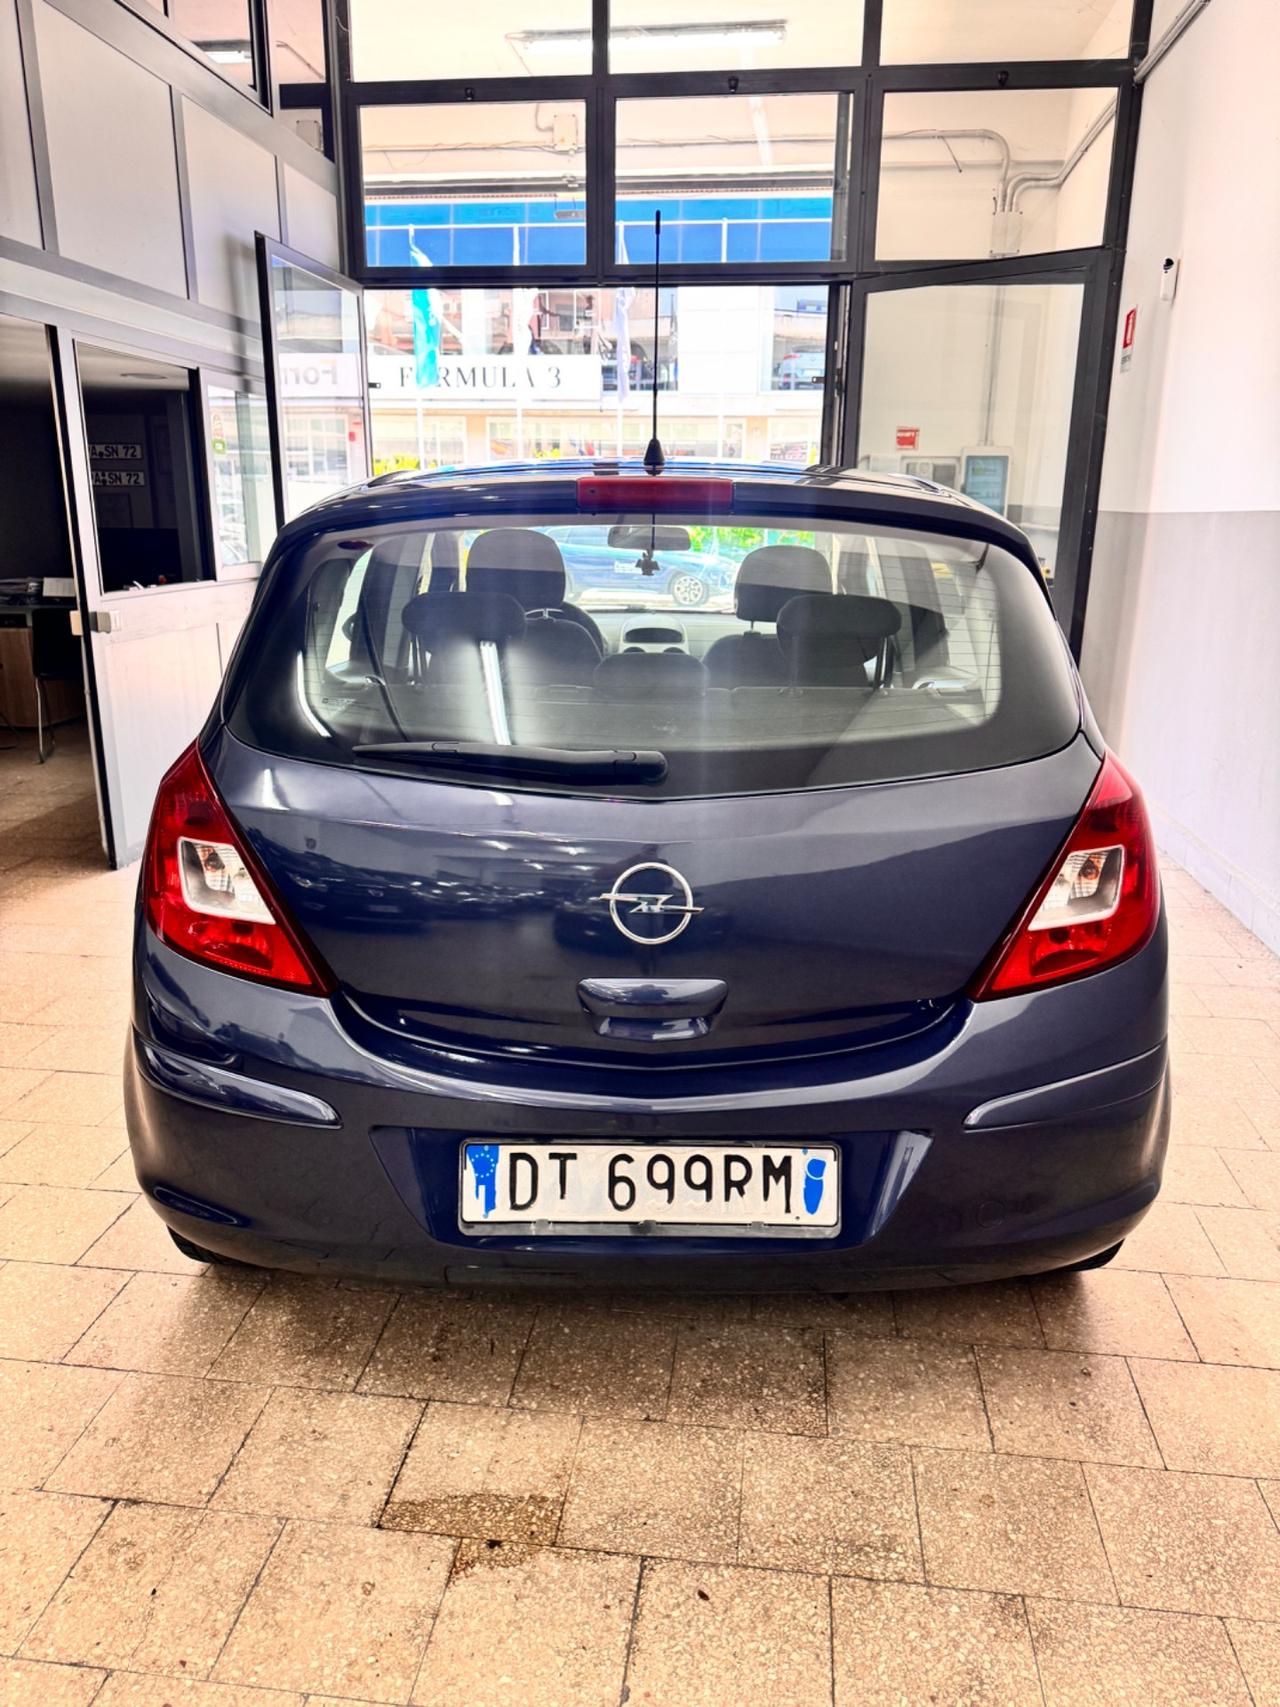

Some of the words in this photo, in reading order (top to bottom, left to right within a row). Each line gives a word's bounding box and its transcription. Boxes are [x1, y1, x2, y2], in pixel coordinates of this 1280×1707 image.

[399, 366, 535, 389] FRMULA
[547, 366, 562, 389] 3
[122, 445, 138, 458] 72
[126, 472, 141, 485] 72
[508, 1151, 578, 1211] DT
[607, 1151, 793, 1215] 699RM
